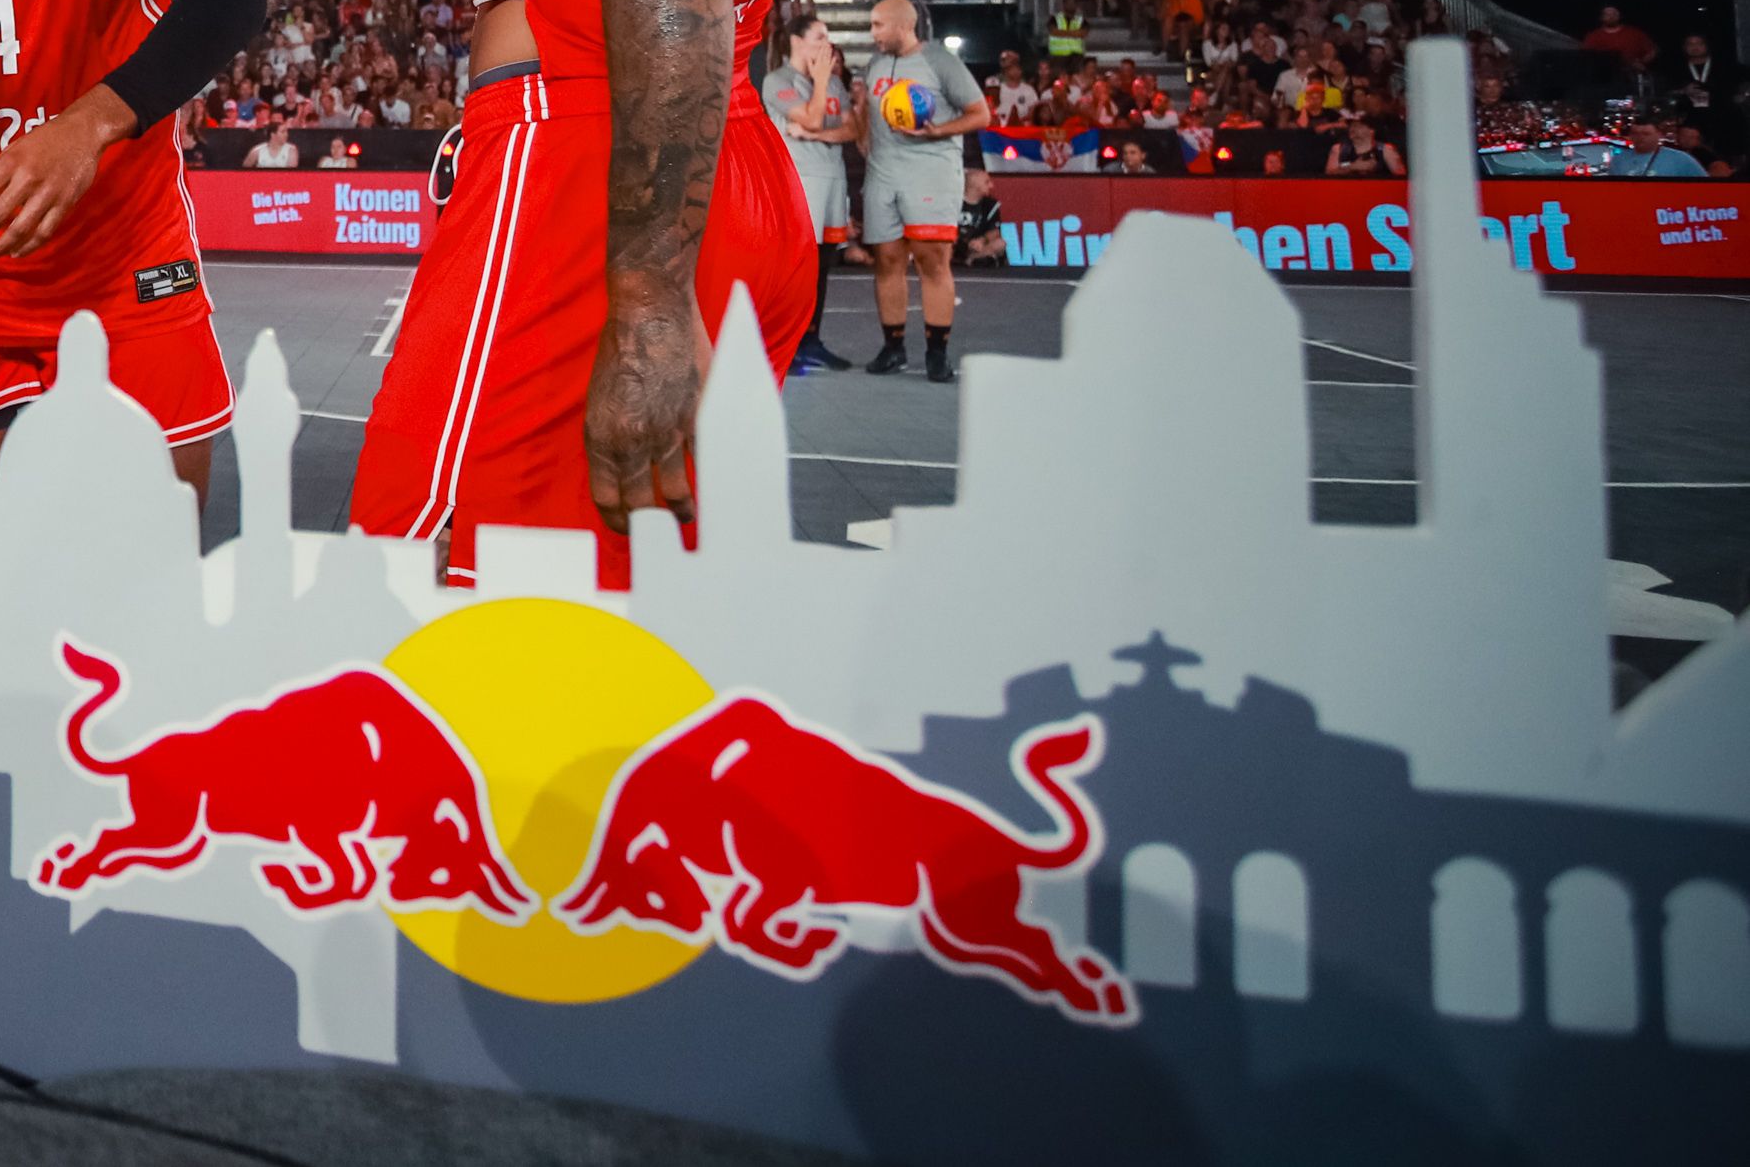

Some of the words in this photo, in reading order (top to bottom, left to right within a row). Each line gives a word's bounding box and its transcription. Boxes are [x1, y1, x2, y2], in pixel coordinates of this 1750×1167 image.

[252, 192, 273, 208] Die
[273, 191, 310, 206] Krone
[334, 183, 420, 212] Kronen
[254, 209, 277, 225] und
[1656, 208, 1684, 225] Die
[1687, 205, 1739, 222] Krone
[334, 215, 420, 248] Zeitung
[1660, 228, 1693, 245] und
[175, 264, 189, 279] XL
